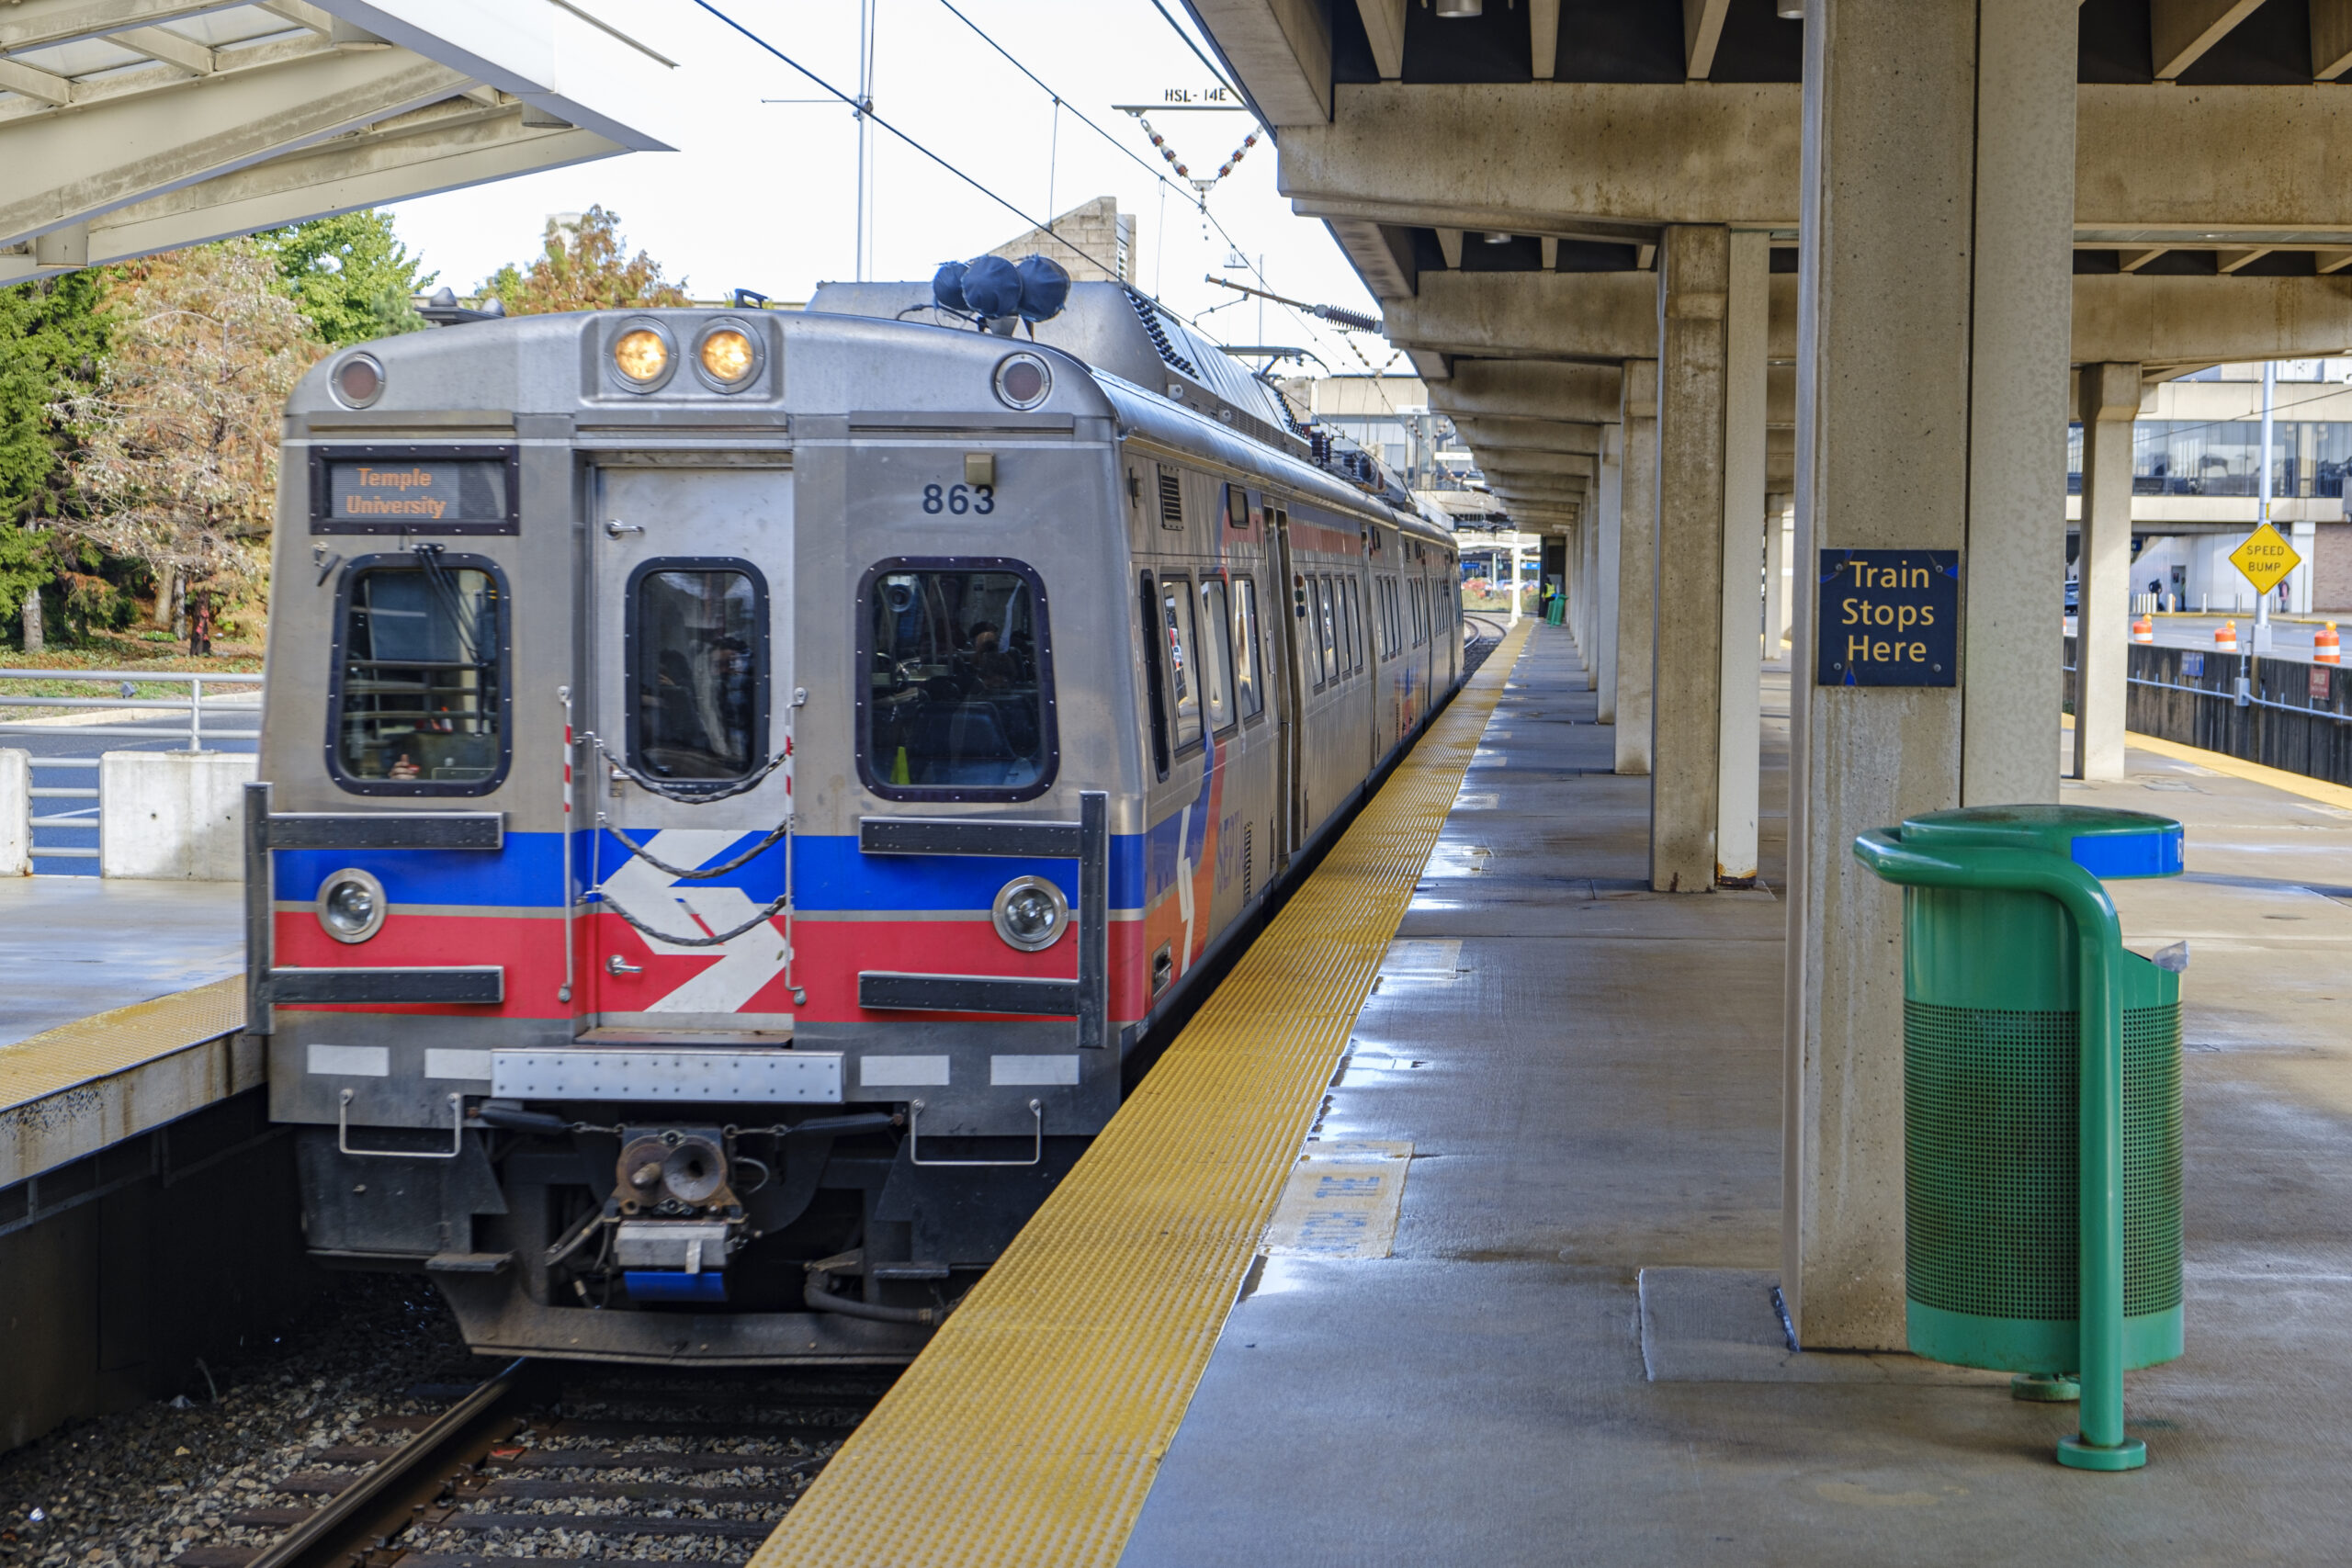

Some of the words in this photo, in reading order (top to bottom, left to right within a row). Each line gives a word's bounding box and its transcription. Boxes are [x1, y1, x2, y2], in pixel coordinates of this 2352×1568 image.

[356, 468, 433, 491] Temple
[346, 495, 447, 519] University
[922, 483, 994, 515] 863
[2246, 545, 2285, 556] SPEED
[1849, 559, 1929, 589] Train
[2248, 561, 2281, 572] BUMP
[1842, 597, 1935, 633] Stops
[1848, 635, 1927, 662] Here
